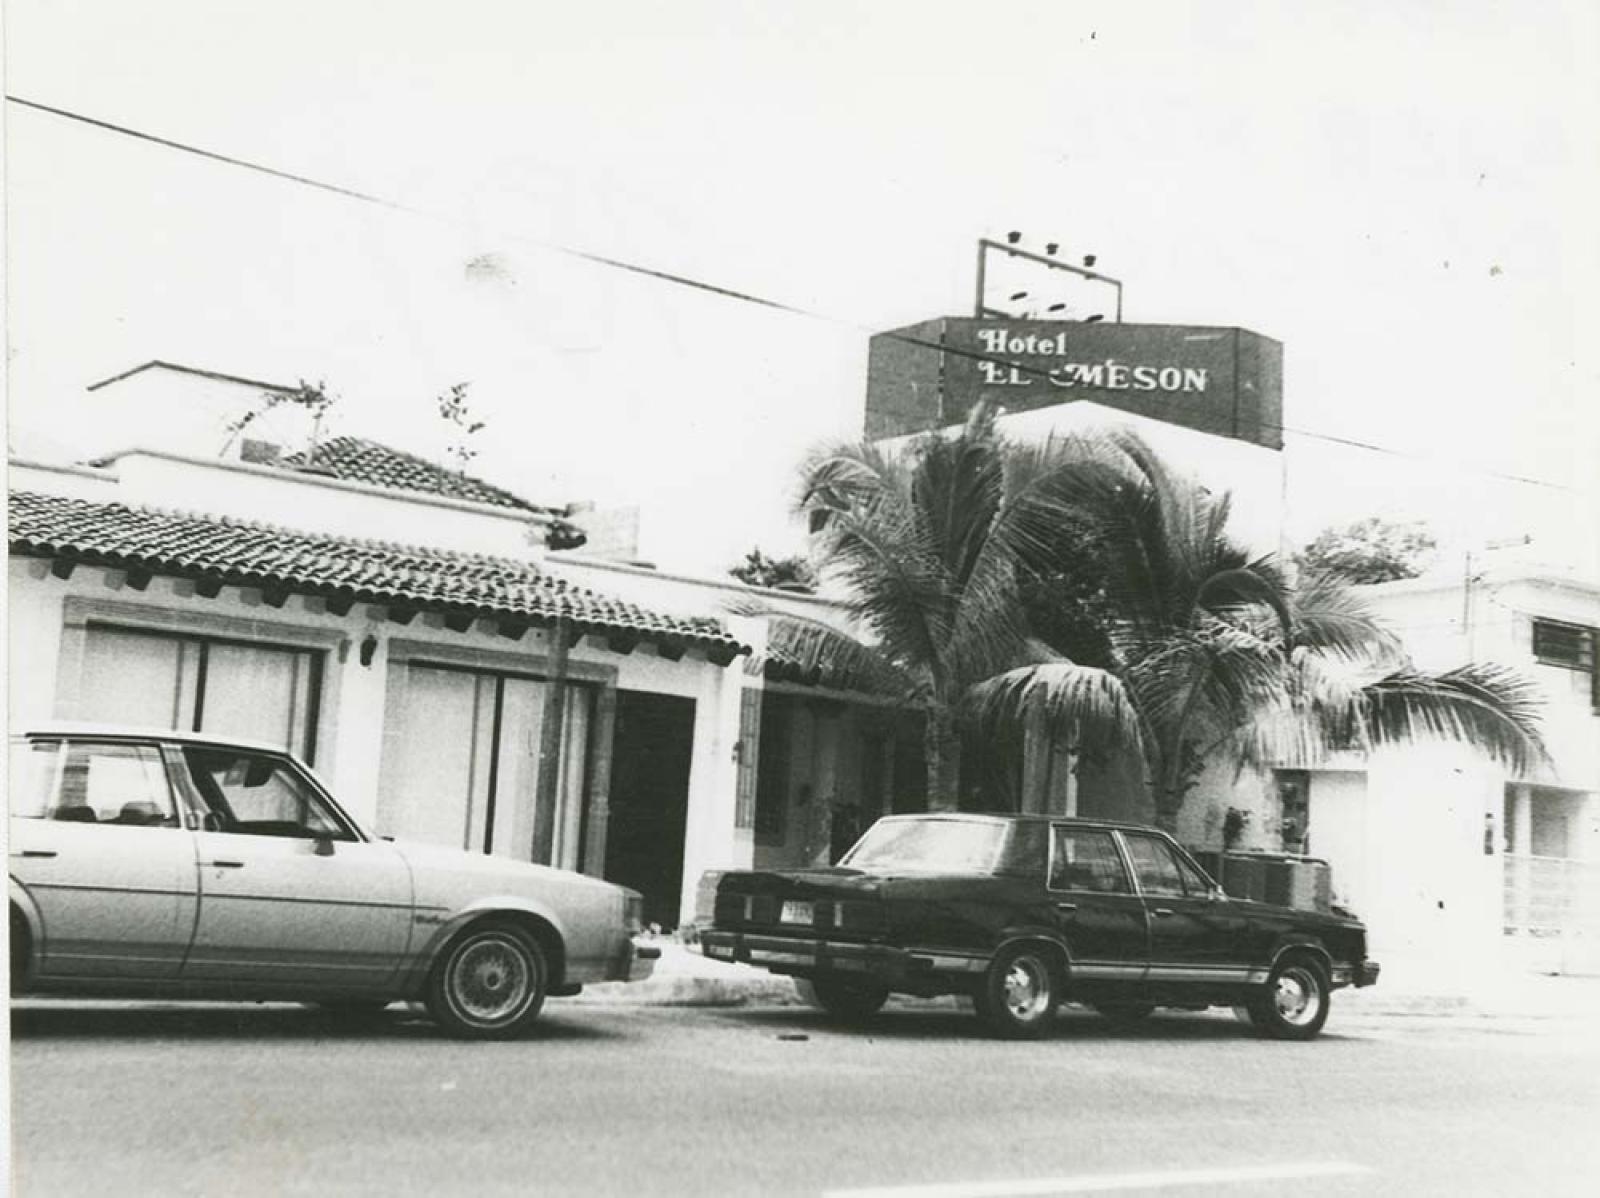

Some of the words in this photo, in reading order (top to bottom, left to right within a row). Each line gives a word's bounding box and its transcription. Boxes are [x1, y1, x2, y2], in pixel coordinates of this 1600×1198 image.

[978, 329, 1067, 356] Hotel
[978, 360, 1033, 385] EL
[1049, 359, 1208, 393] MESON
